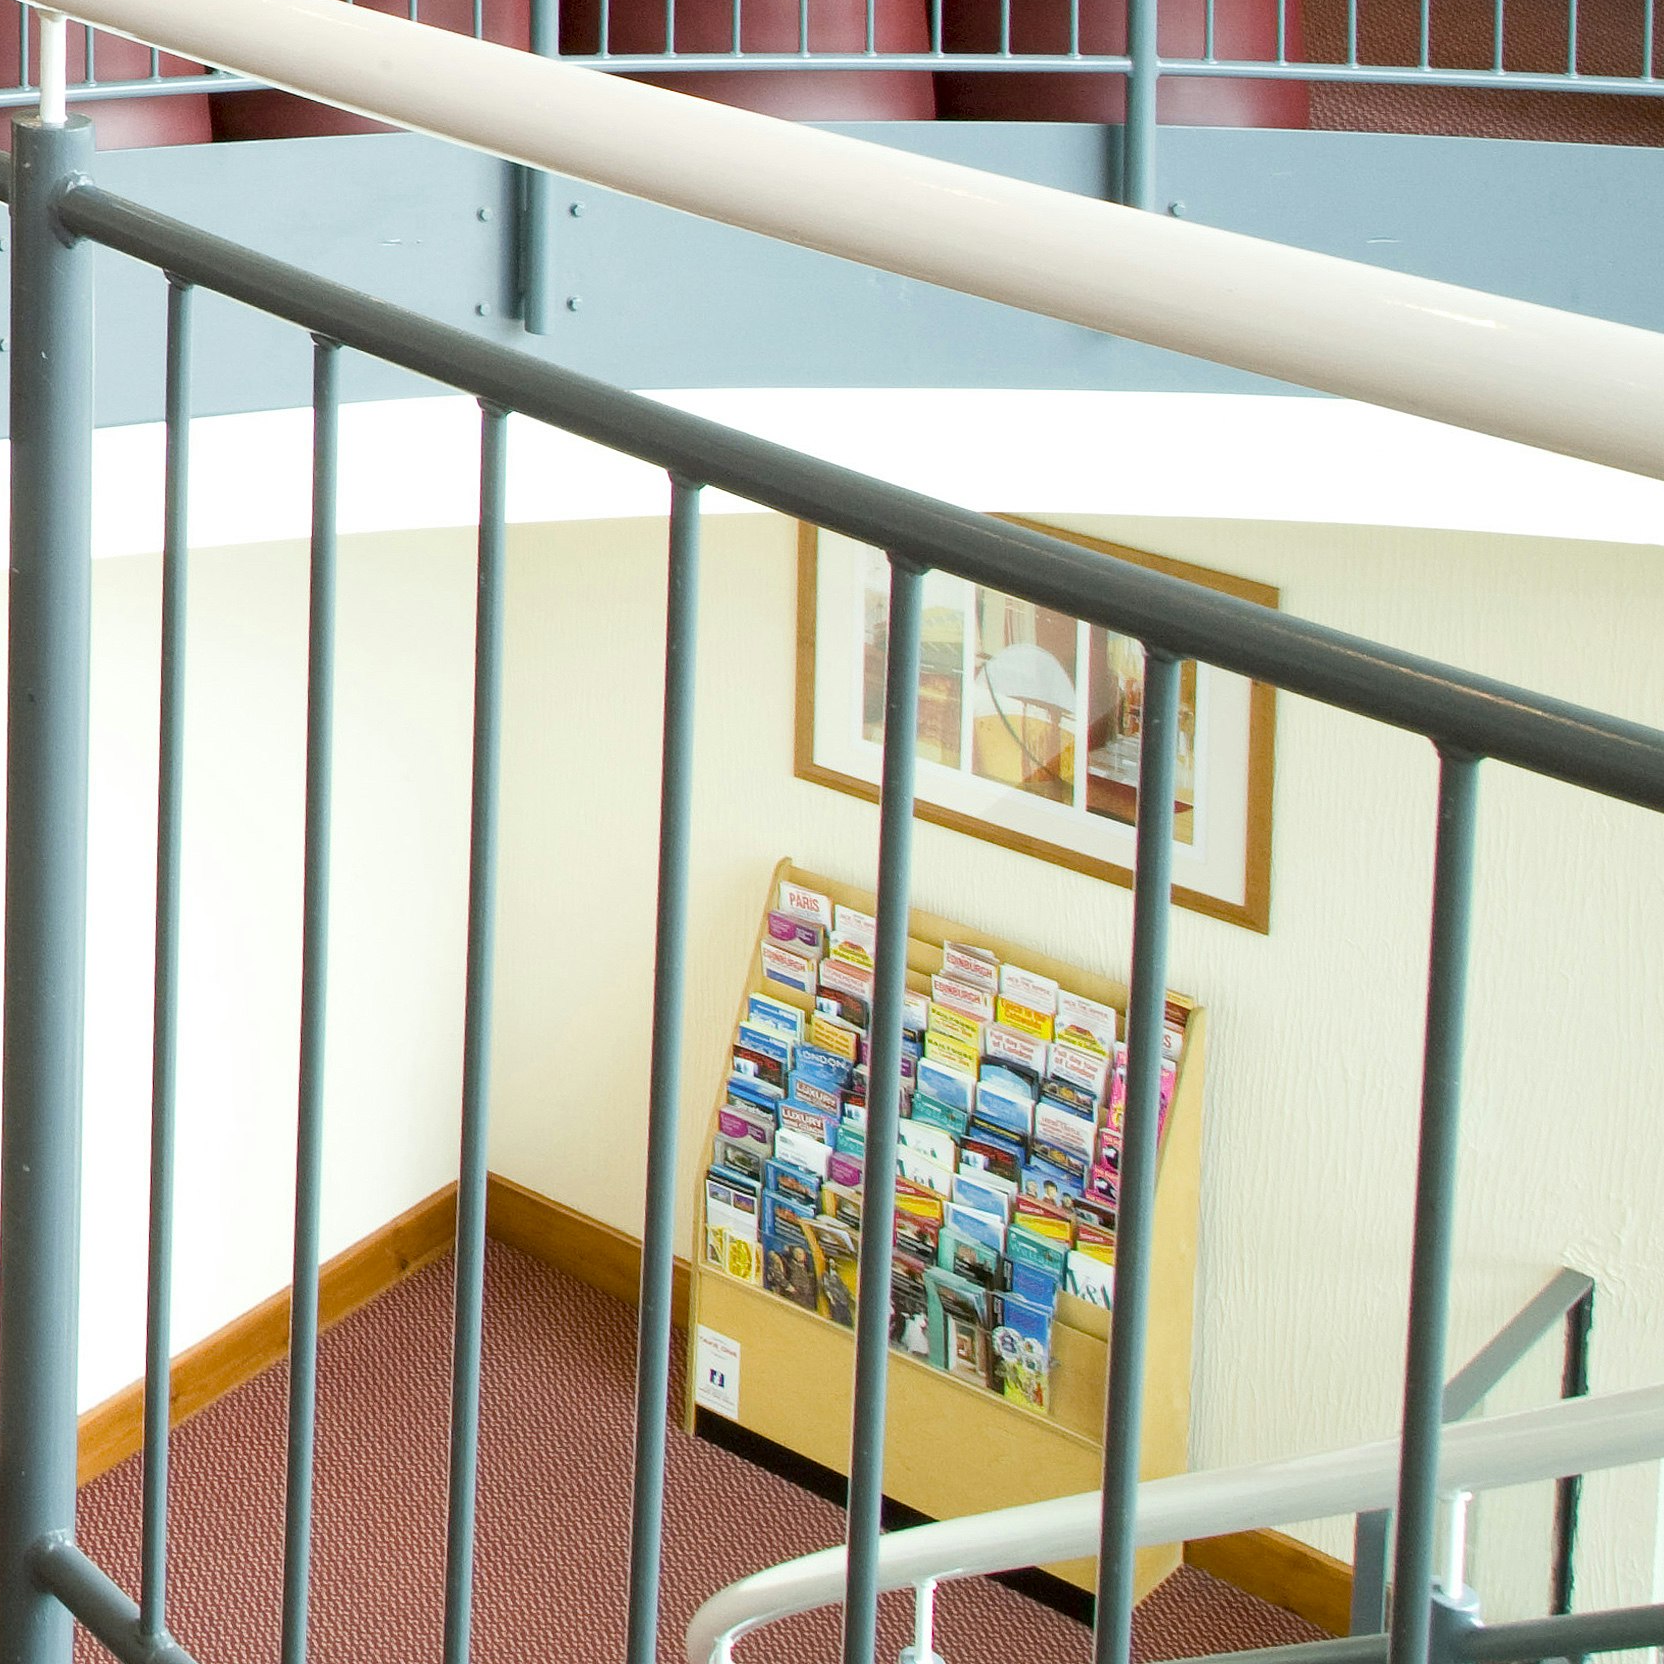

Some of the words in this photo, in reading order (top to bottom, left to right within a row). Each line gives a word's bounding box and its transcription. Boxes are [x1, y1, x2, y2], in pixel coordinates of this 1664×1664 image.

[788, 892, 820, 913] PARIS
[763, 947, 806, 972] EDINBURGH
[946, 952, 993, 977] EDINBURGH
[934, 980, 981, 1004] EDINBURGH
[782, 1105, 824, 1128] LUXURY
